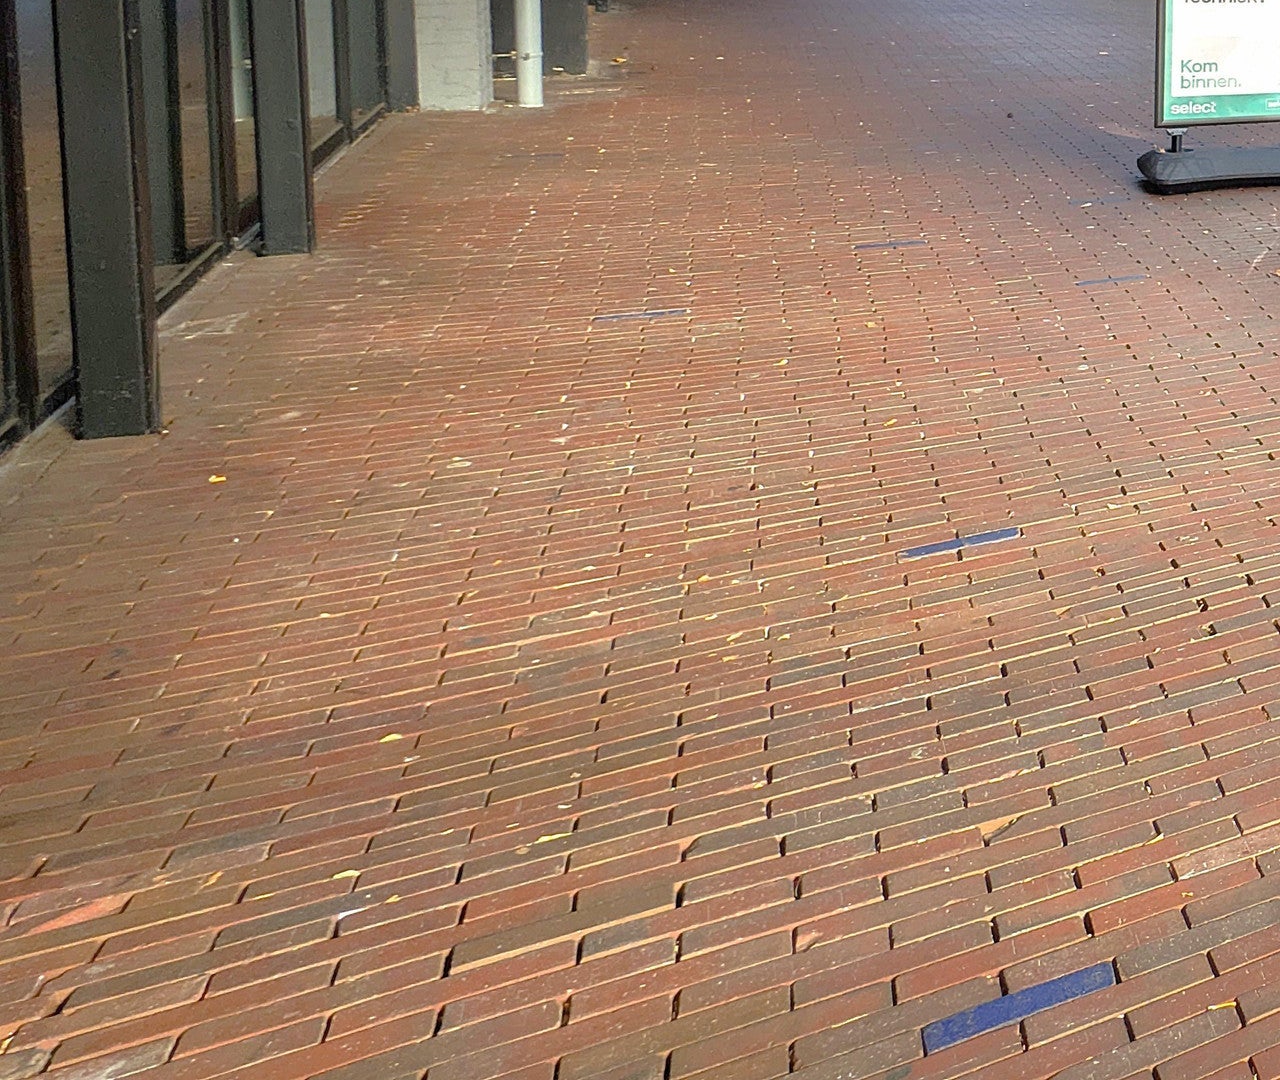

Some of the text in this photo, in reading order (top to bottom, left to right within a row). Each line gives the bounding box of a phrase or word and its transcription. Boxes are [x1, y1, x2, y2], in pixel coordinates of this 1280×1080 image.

[1180, 59, 1218, 73] Kom
[1180, 75, 1242, 89] binnen.
[1170, 101, 1217, 115] select
